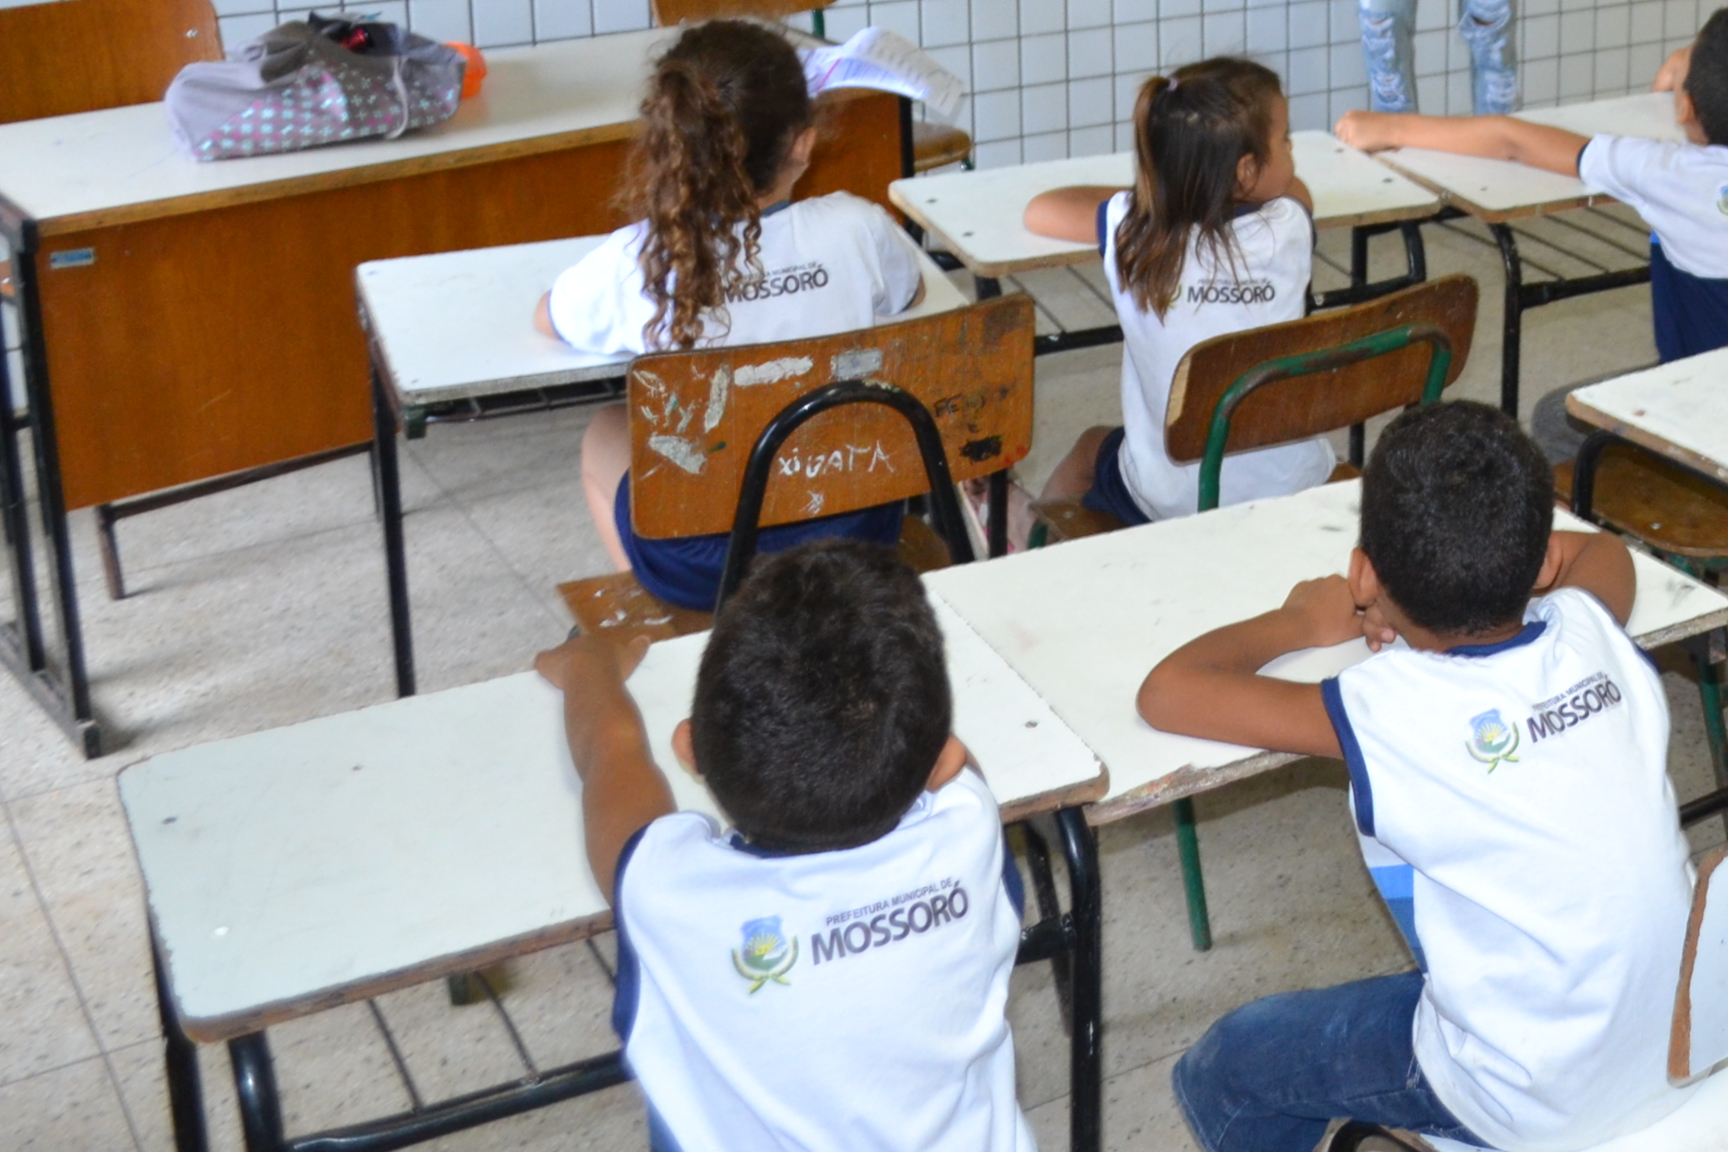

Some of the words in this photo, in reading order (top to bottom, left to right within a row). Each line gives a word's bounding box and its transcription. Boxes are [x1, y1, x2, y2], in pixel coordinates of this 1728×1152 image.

[1187, 281, 1276, 304] MOSSORÓ
[1526, 674, 1622, 743] MOSSORÓ
[810, 880, 970, 966] MOSSORÓ
[826, 900, 890, 927] PREFEITURA
[890, 883, 940, 908] MUNICIPAL
[939, 877, 954, 890] DE
